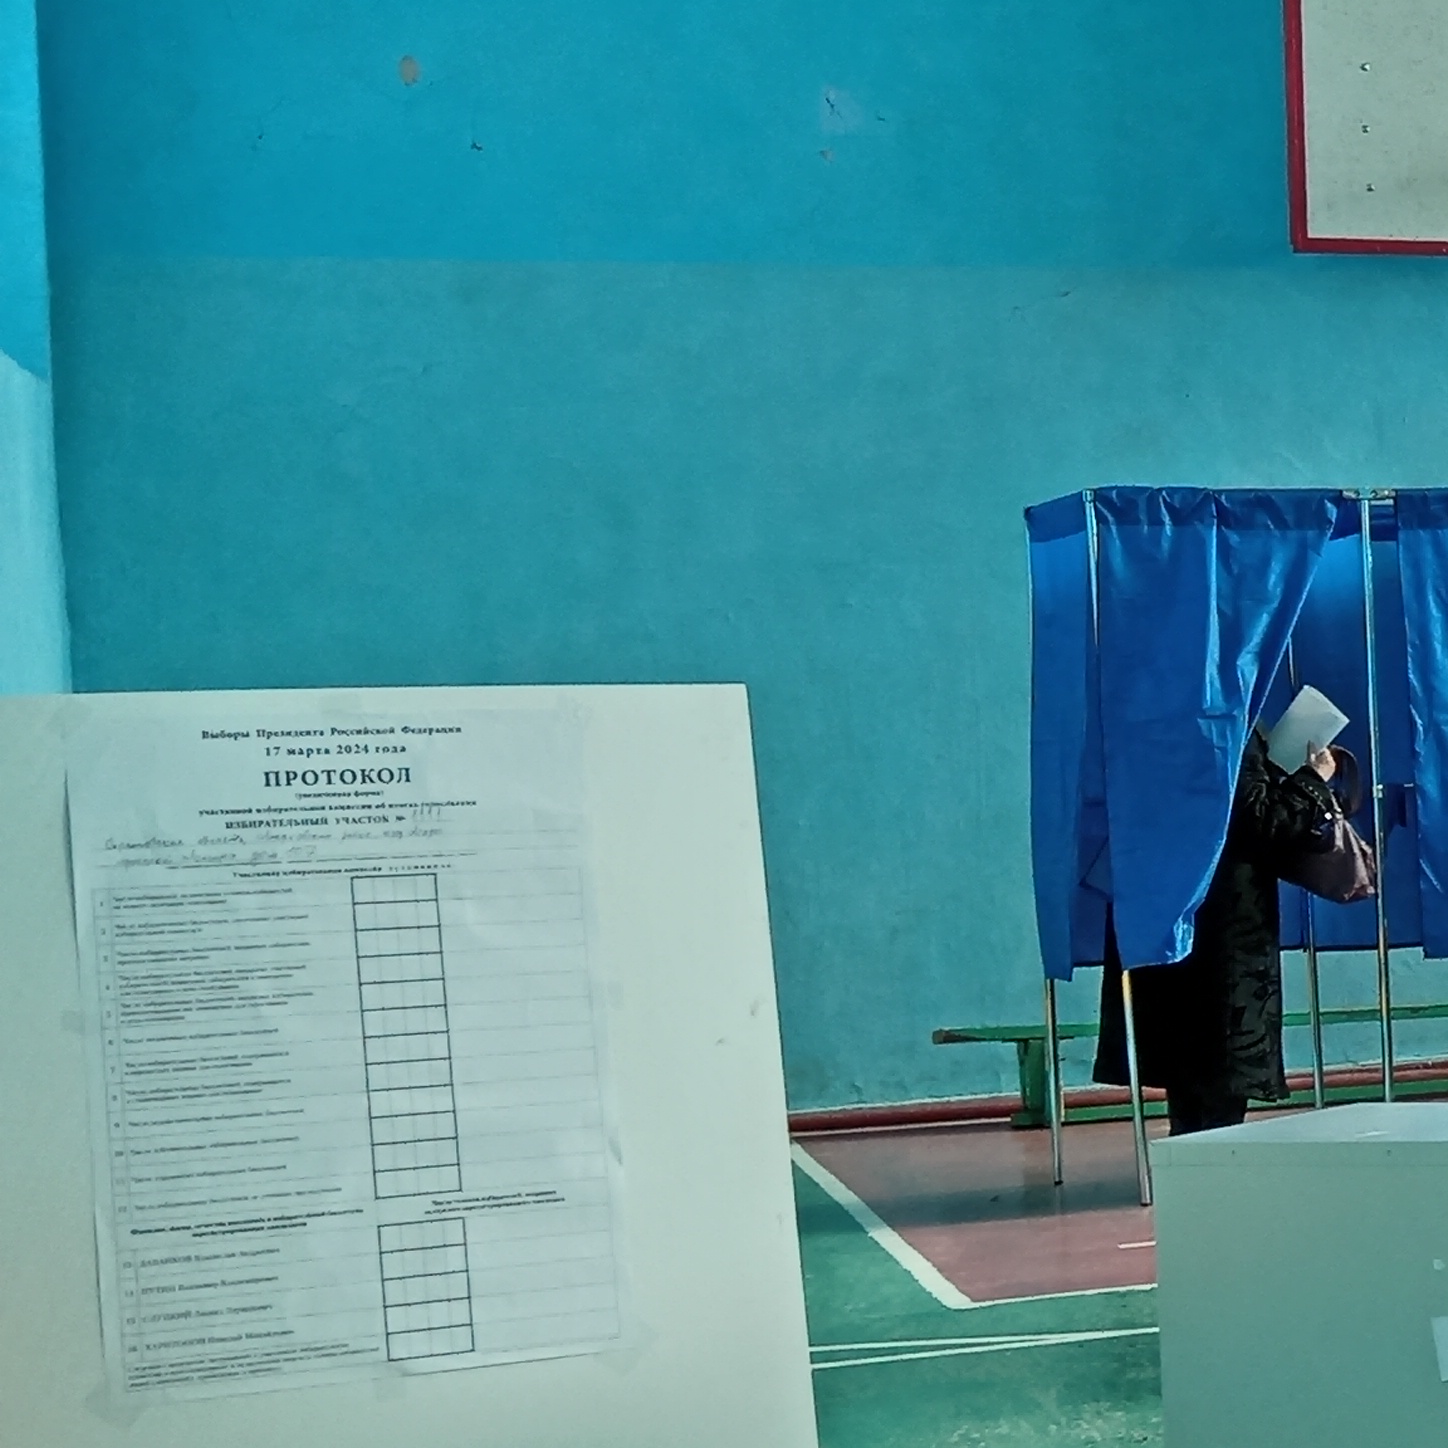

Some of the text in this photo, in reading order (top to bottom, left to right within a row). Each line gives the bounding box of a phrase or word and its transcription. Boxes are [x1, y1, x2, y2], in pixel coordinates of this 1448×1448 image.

[201, 725, 462, 741] Выборы Президента Российской Федерации
[263, 743, 407, 759] 17 марта 2024 года
[263, 767, 411, 788] ПРОТОКОЛ
[225, 816, 329, 830] ИЗБИРАТЕЛЬНЫЙ
[334, 814, 390, 826] УЧАСТОК
